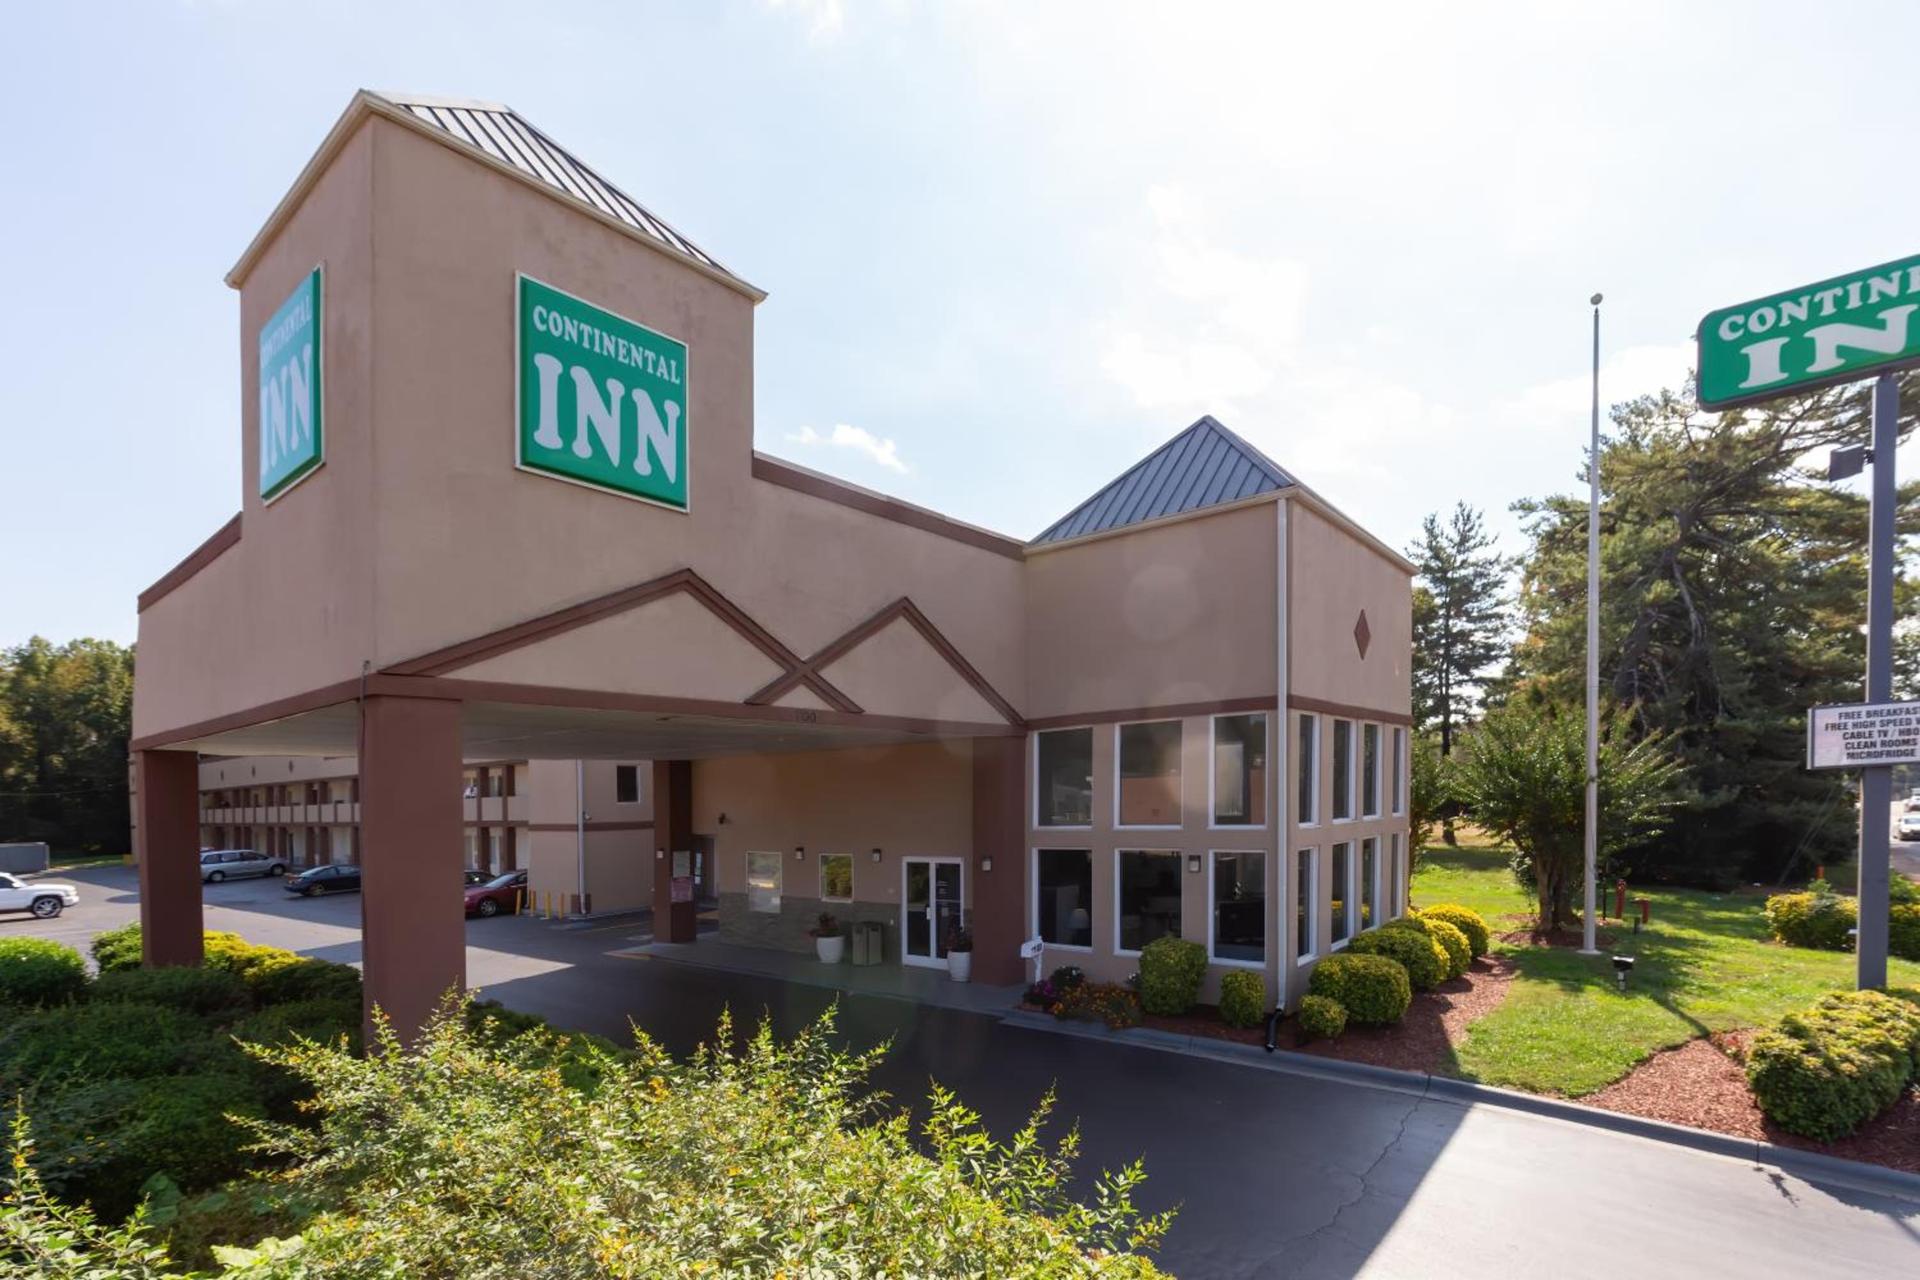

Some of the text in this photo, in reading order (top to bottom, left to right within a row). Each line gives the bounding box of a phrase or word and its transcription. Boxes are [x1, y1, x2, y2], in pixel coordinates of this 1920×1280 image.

[533, 305, 680, 384] CONTINENTAL
[261, 343, 312, 476] INN
[533, 353, 680, 484] INN
[1839, 711, 1862, 720] FREE
[1825, 722, 1848, 731] FREE
[1852, 720, 1876, 729] HIGH
[1879, 718, 1912, 727] SPEED
[1843, 730, 1874, 740] CABLE
[1878, 729, 1889, 738] TV
[1898, 727, 1920, 736] HBO
[1845, 738, 1918, 750] CLEAN ROOMS
[1846, 749, 1916, 759] MICROFRIDGE
